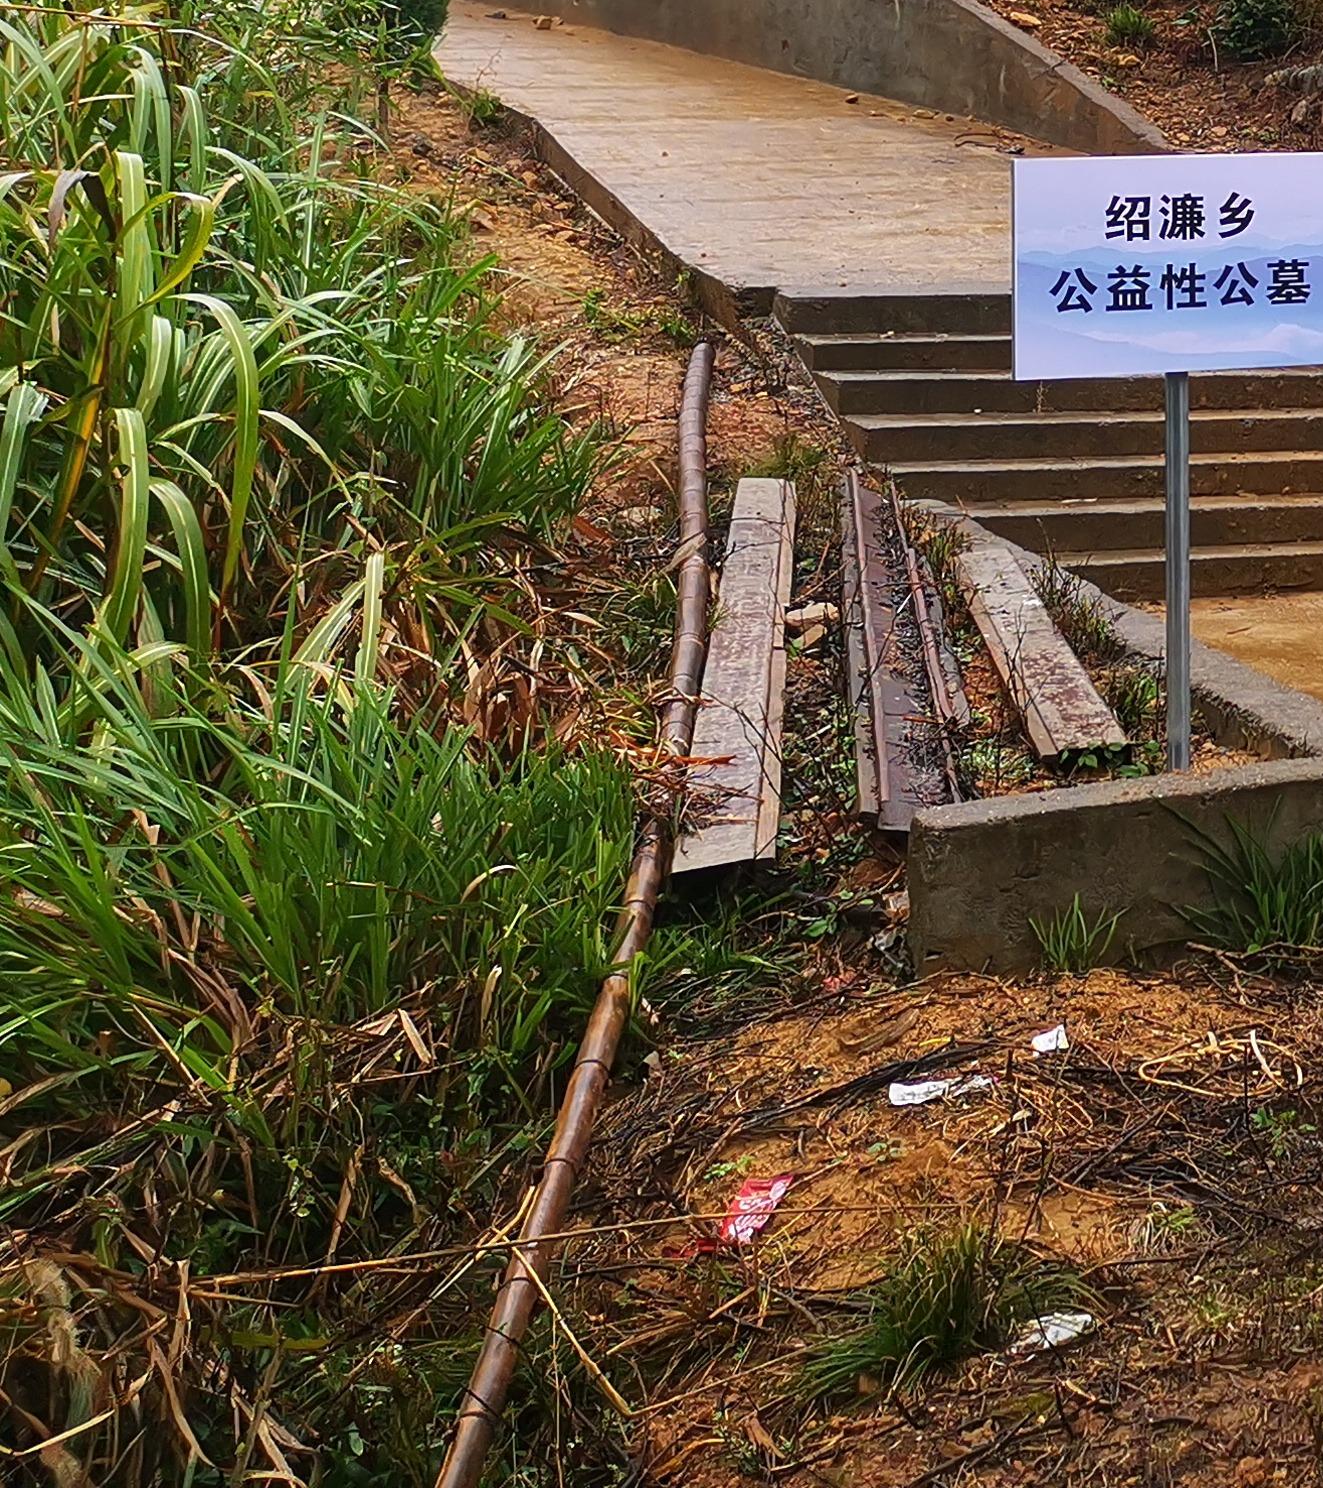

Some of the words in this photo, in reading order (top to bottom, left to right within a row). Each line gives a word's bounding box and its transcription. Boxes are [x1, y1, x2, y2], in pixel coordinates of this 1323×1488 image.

[1105, 192, 1255, 241] 绍濂乡
[1049, 259, 1312, 313] 公益性公墓
